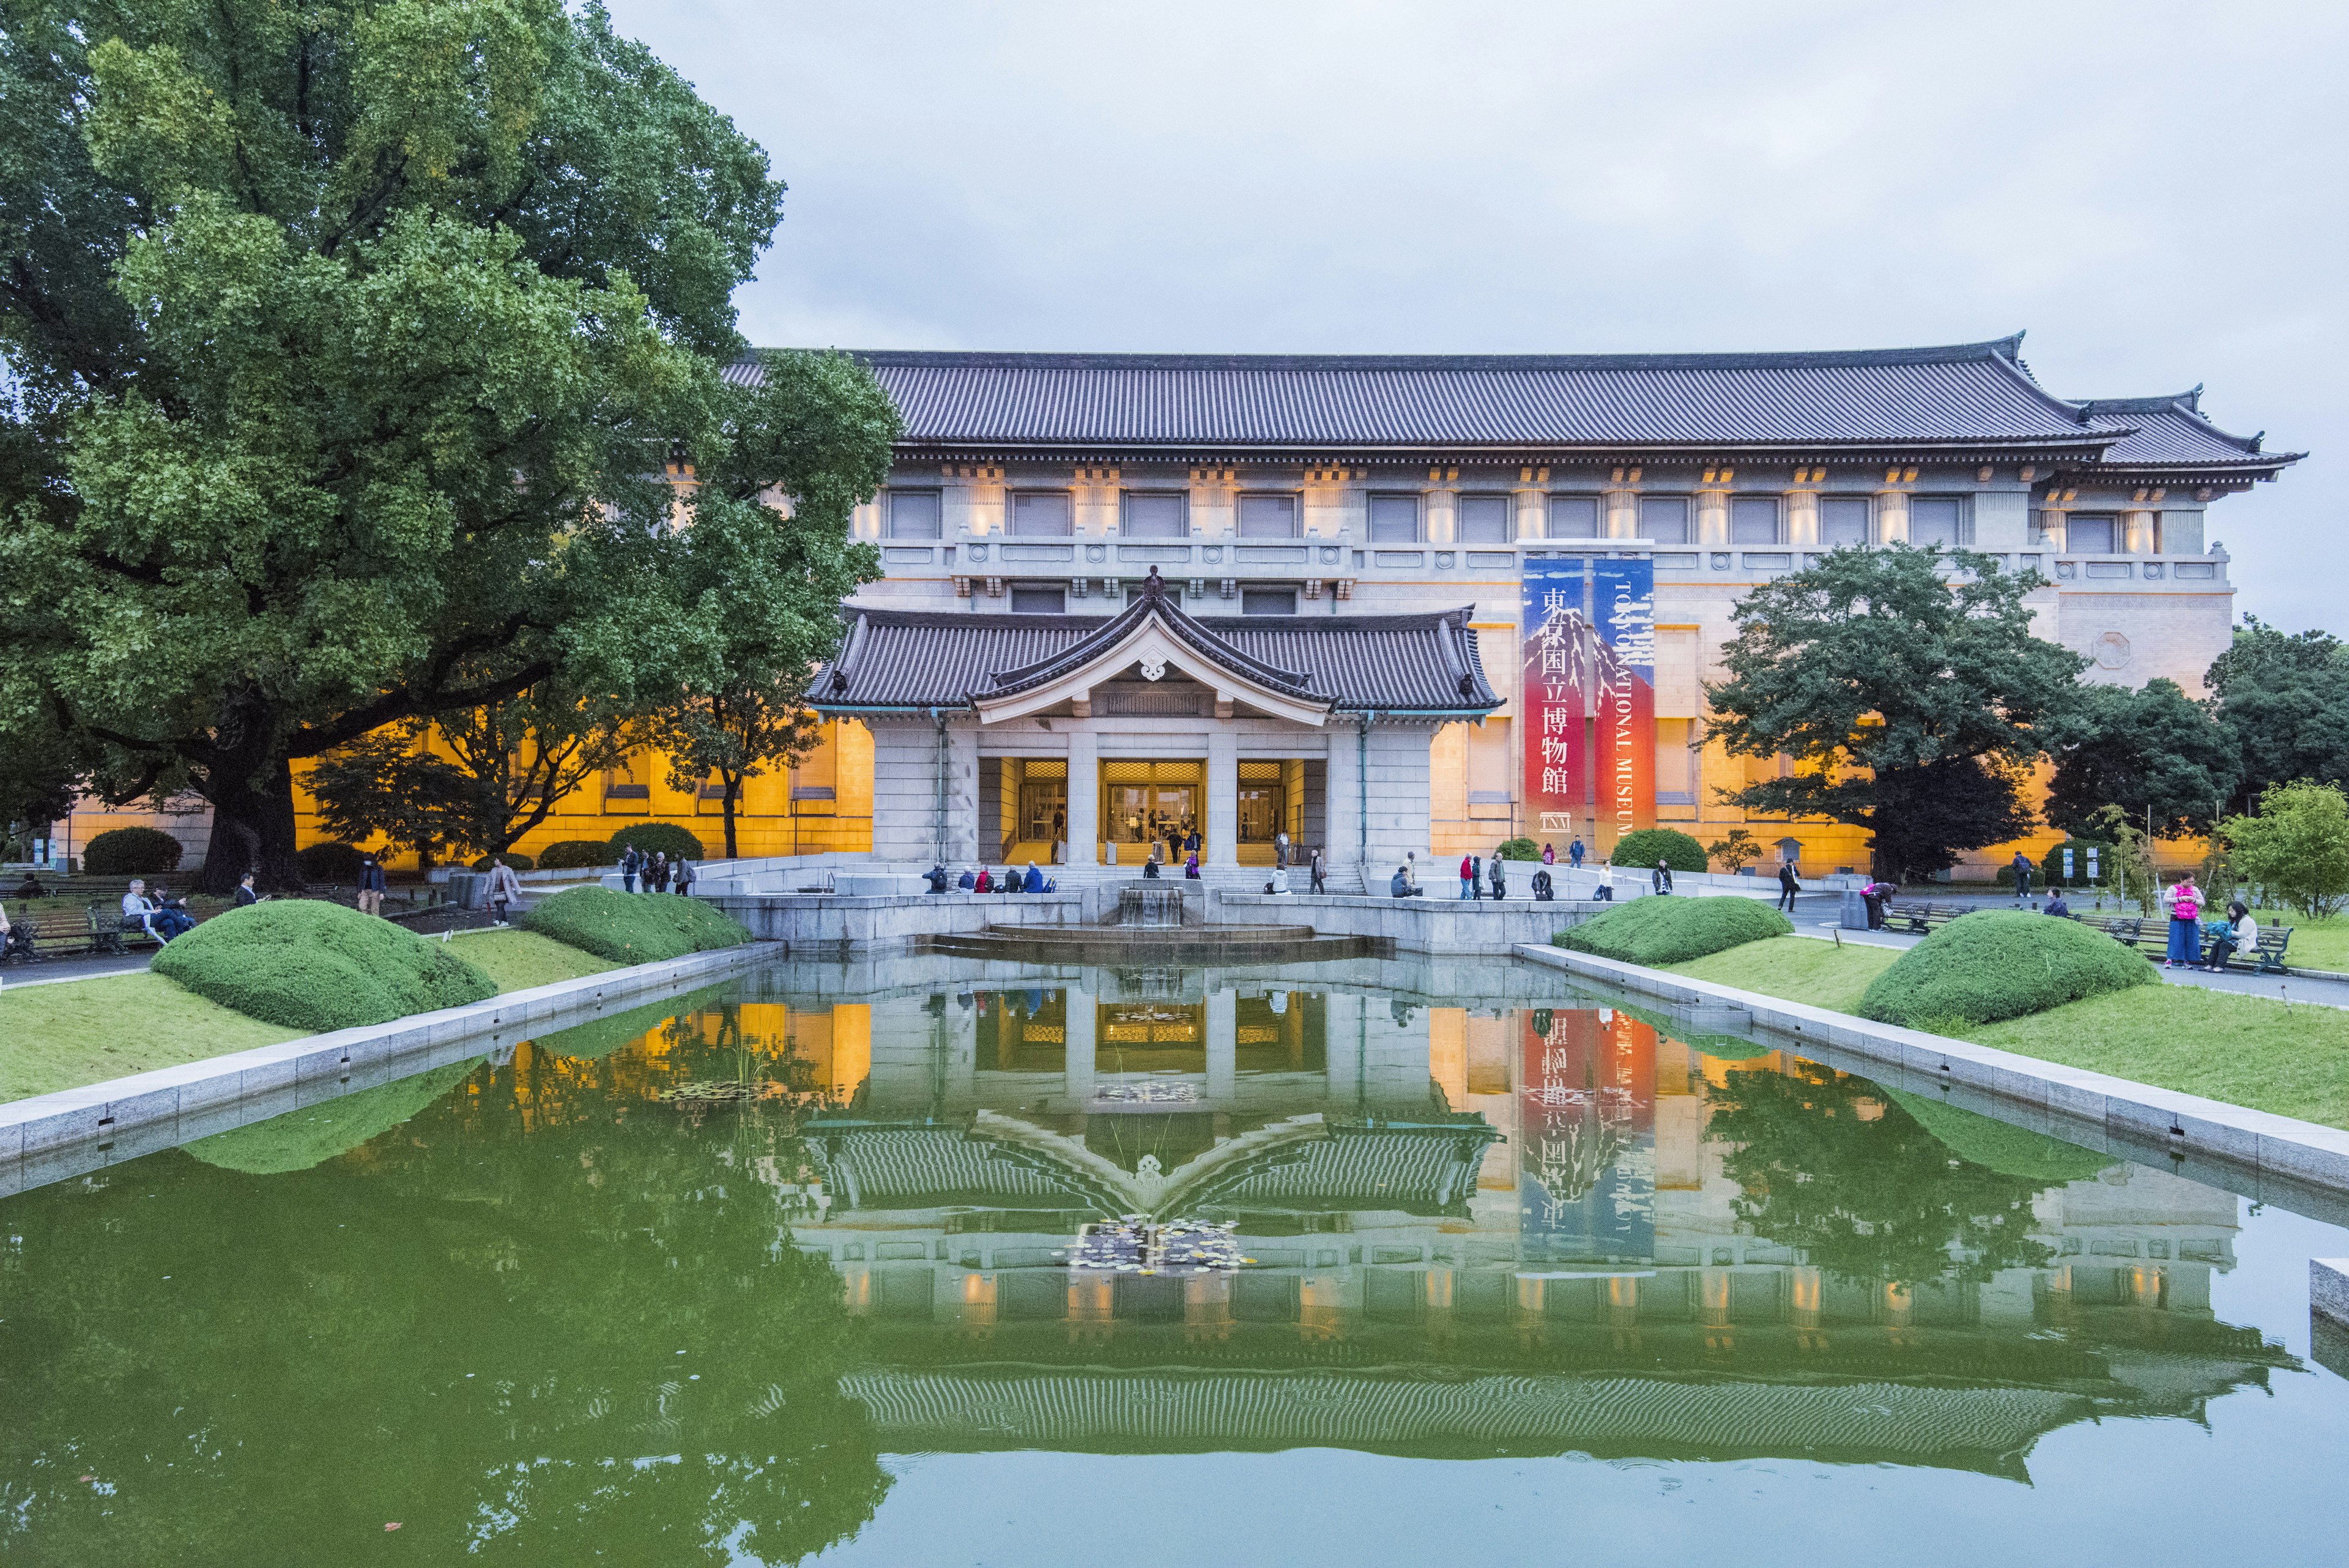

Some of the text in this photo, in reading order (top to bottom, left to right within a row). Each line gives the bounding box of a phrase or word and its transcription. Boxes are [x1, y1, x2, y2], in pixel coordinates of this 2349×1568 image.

[1541, 588, 1568, 794] 東京国立博物館
[1615, 581, 1633, 838] TOKYO NATIONAL MUSEUM
[1539, 817, 1571, 830] TNM
